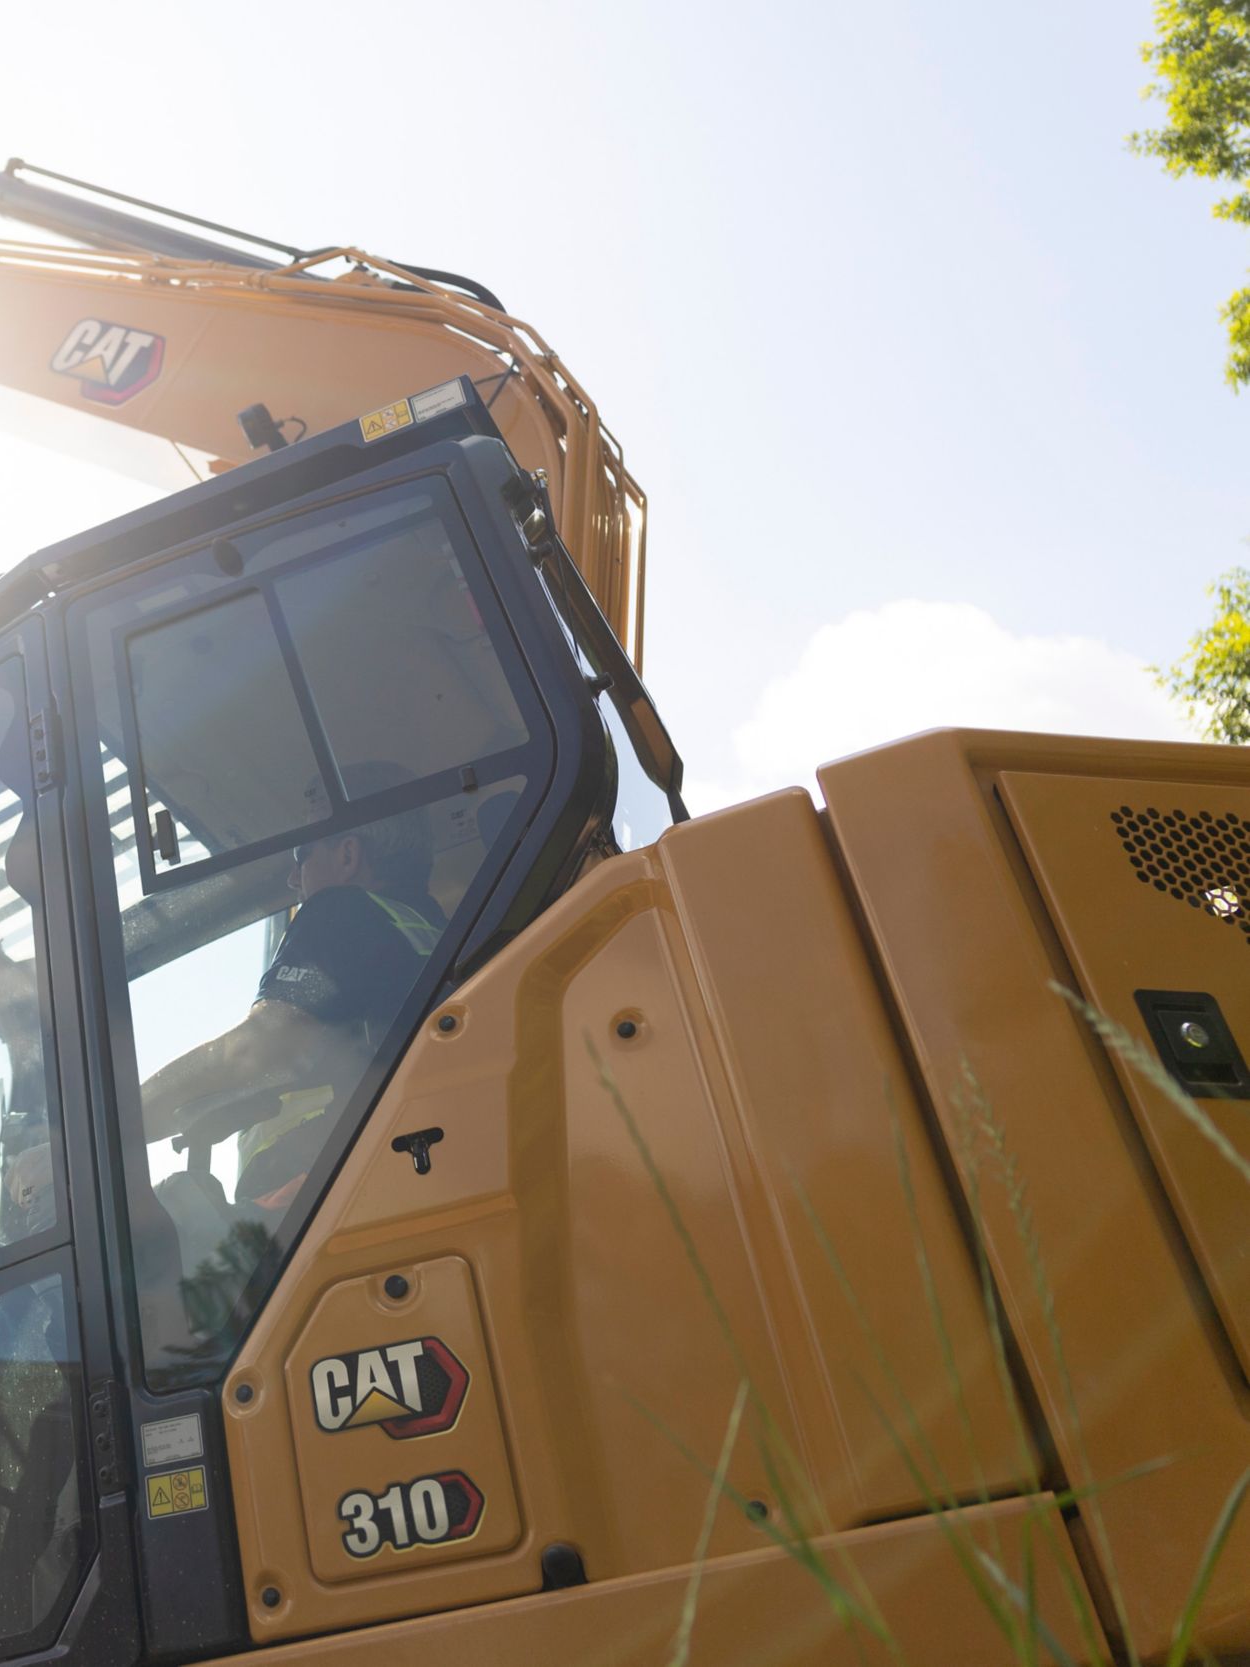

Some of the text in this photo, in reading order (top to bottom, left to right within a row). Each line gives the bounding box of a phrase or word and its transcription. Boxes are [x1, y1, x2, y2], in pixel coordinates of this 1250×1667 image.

[51, 318, 155, 388] CAT
[276, 965, 308, 982] CAT
[312, 1340, 424, 1431] CAT
[341, 1478, 450, 1555] 310
